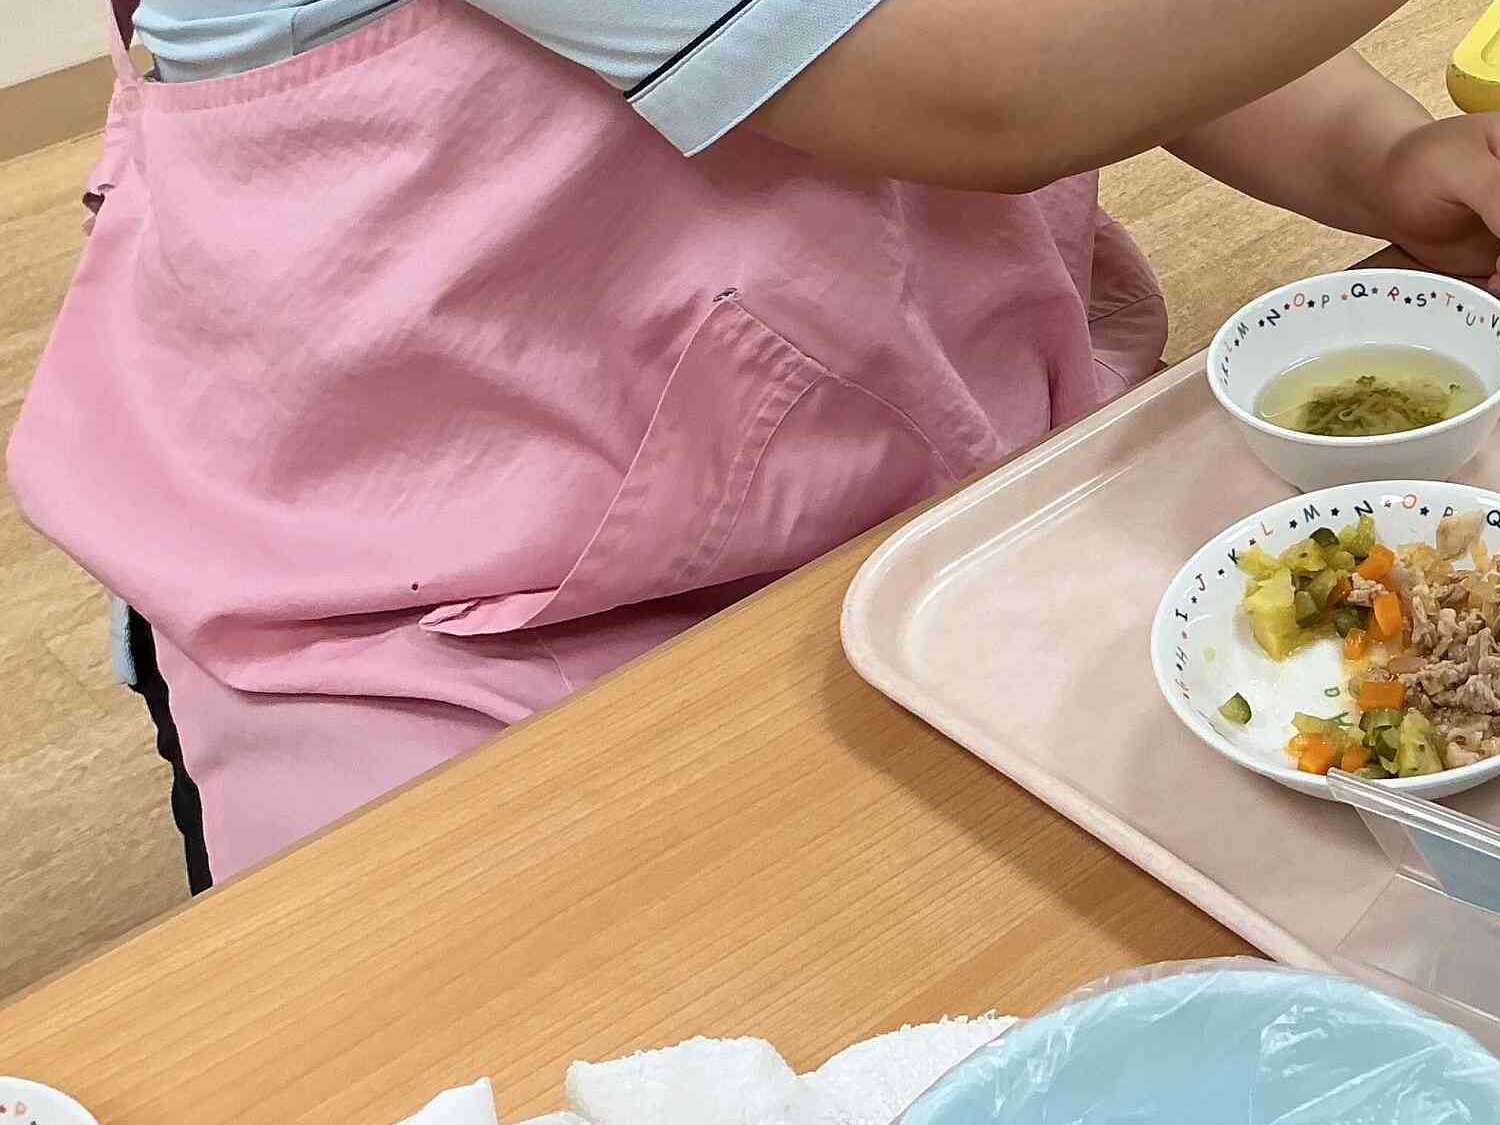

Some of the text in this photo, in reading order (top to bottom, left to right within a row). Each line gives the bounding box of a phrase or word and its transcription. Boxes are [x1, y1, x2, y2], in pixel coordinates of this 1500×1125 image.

[1237, 322, 1250, 340] M
[1266, 307, 1281, 327] N
[1293, 292, 1307, 308] O
[1321, 293, 1331, 309] P
[1350, 281, 1369, 299] Q
[1387, 286, 1401, 302] R
[1415, 293, 1428, 308] S
[1445, 291, 1456, 306] T
[1465, 311, 1477, 327] U
[1490, 313, 1500, 329] V
[1175, 608, 1188, 622] I
[1194, 573, 1206, 591] J
[1260, 521, 1275, 539] L
[1303, 504, 1321, 524] M
[1353, 500, 1374, 517] N
[1402, 493, 1419, 510] O
